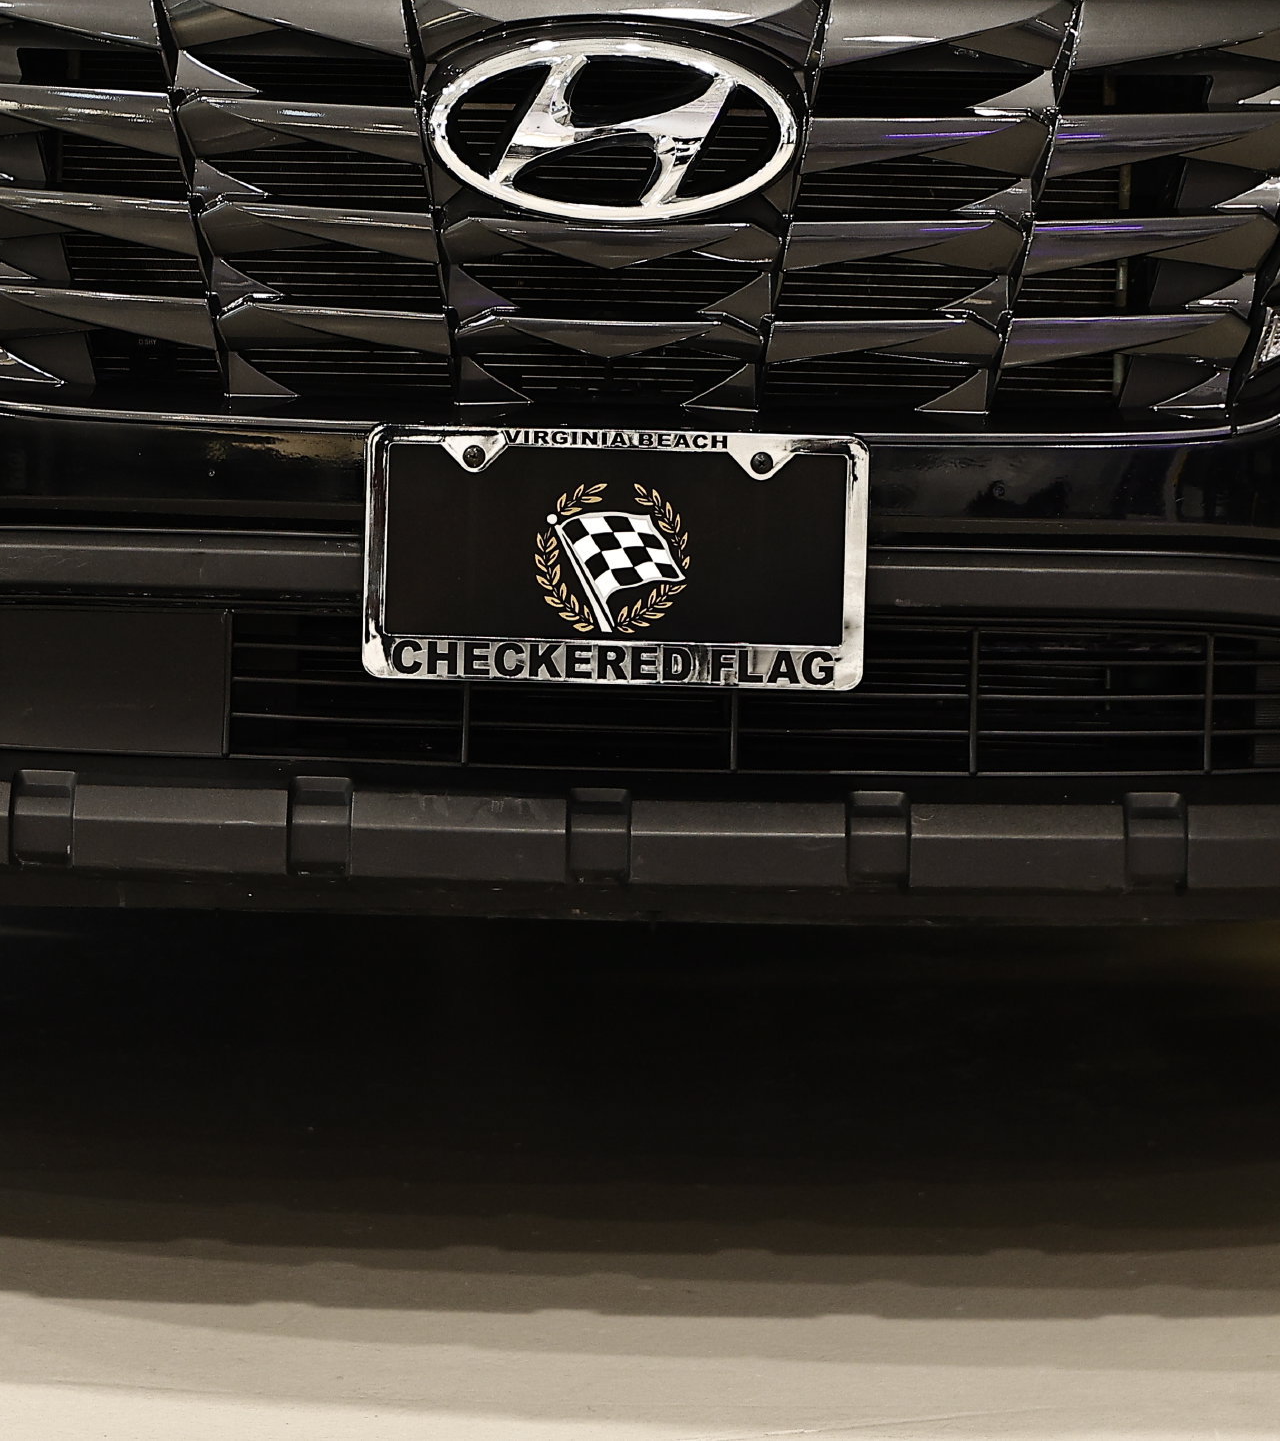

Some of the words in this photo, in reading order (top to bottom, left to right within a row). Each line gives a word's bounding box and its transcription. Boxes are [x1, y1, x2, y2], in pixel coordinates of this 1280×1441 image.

[505, 429, 630, 447] VIRGINIA
[638, 433, 728, 450] BEACH
[391, 639, 692, 683] CHECKERED
[710, 648, 836, 686] FLAG
